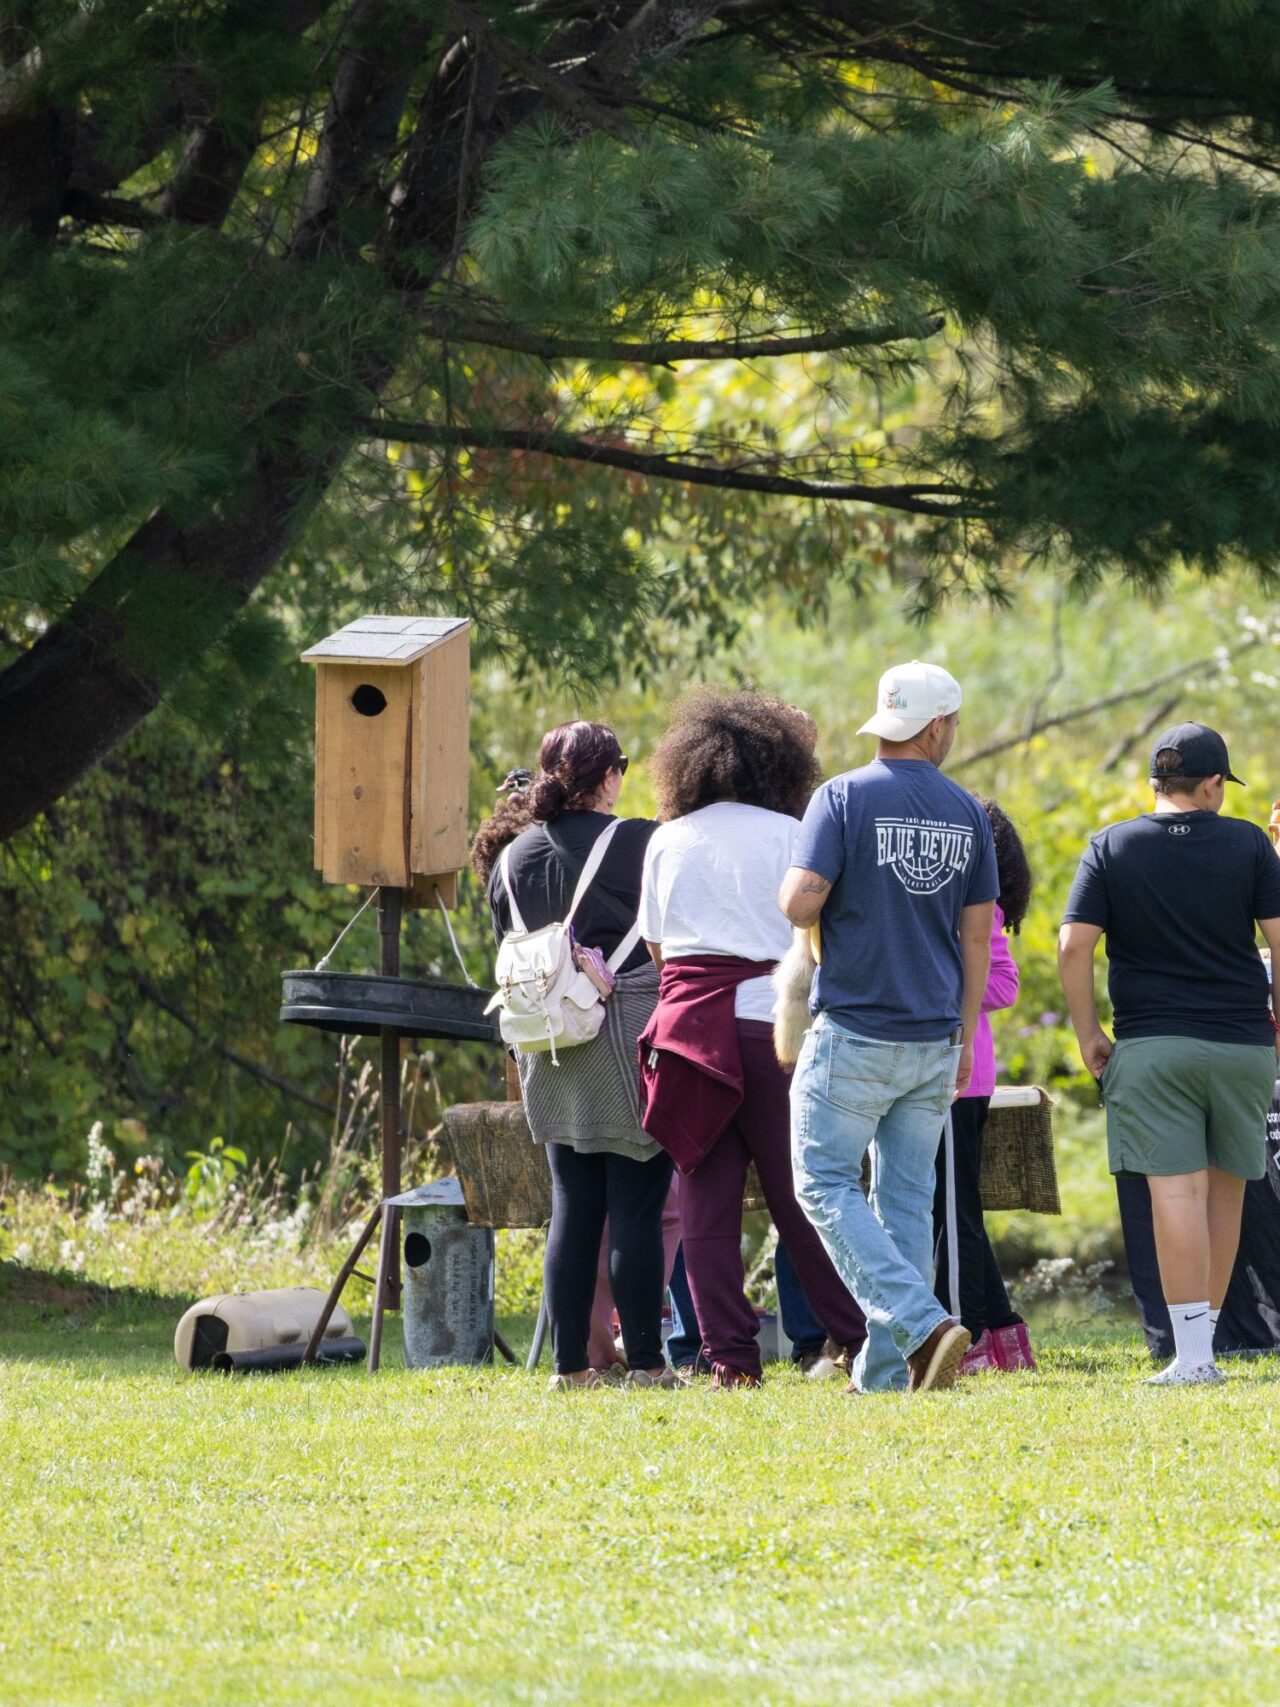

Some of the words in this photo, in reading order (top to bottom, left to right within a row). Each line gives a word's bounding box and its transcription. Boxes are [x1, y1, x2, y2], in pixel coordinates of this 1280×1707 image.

[920, 818, 947, 827] AURORA
[876, 827, 914, 866] BLUE
[919, 830, 973, 873] DEVILS
